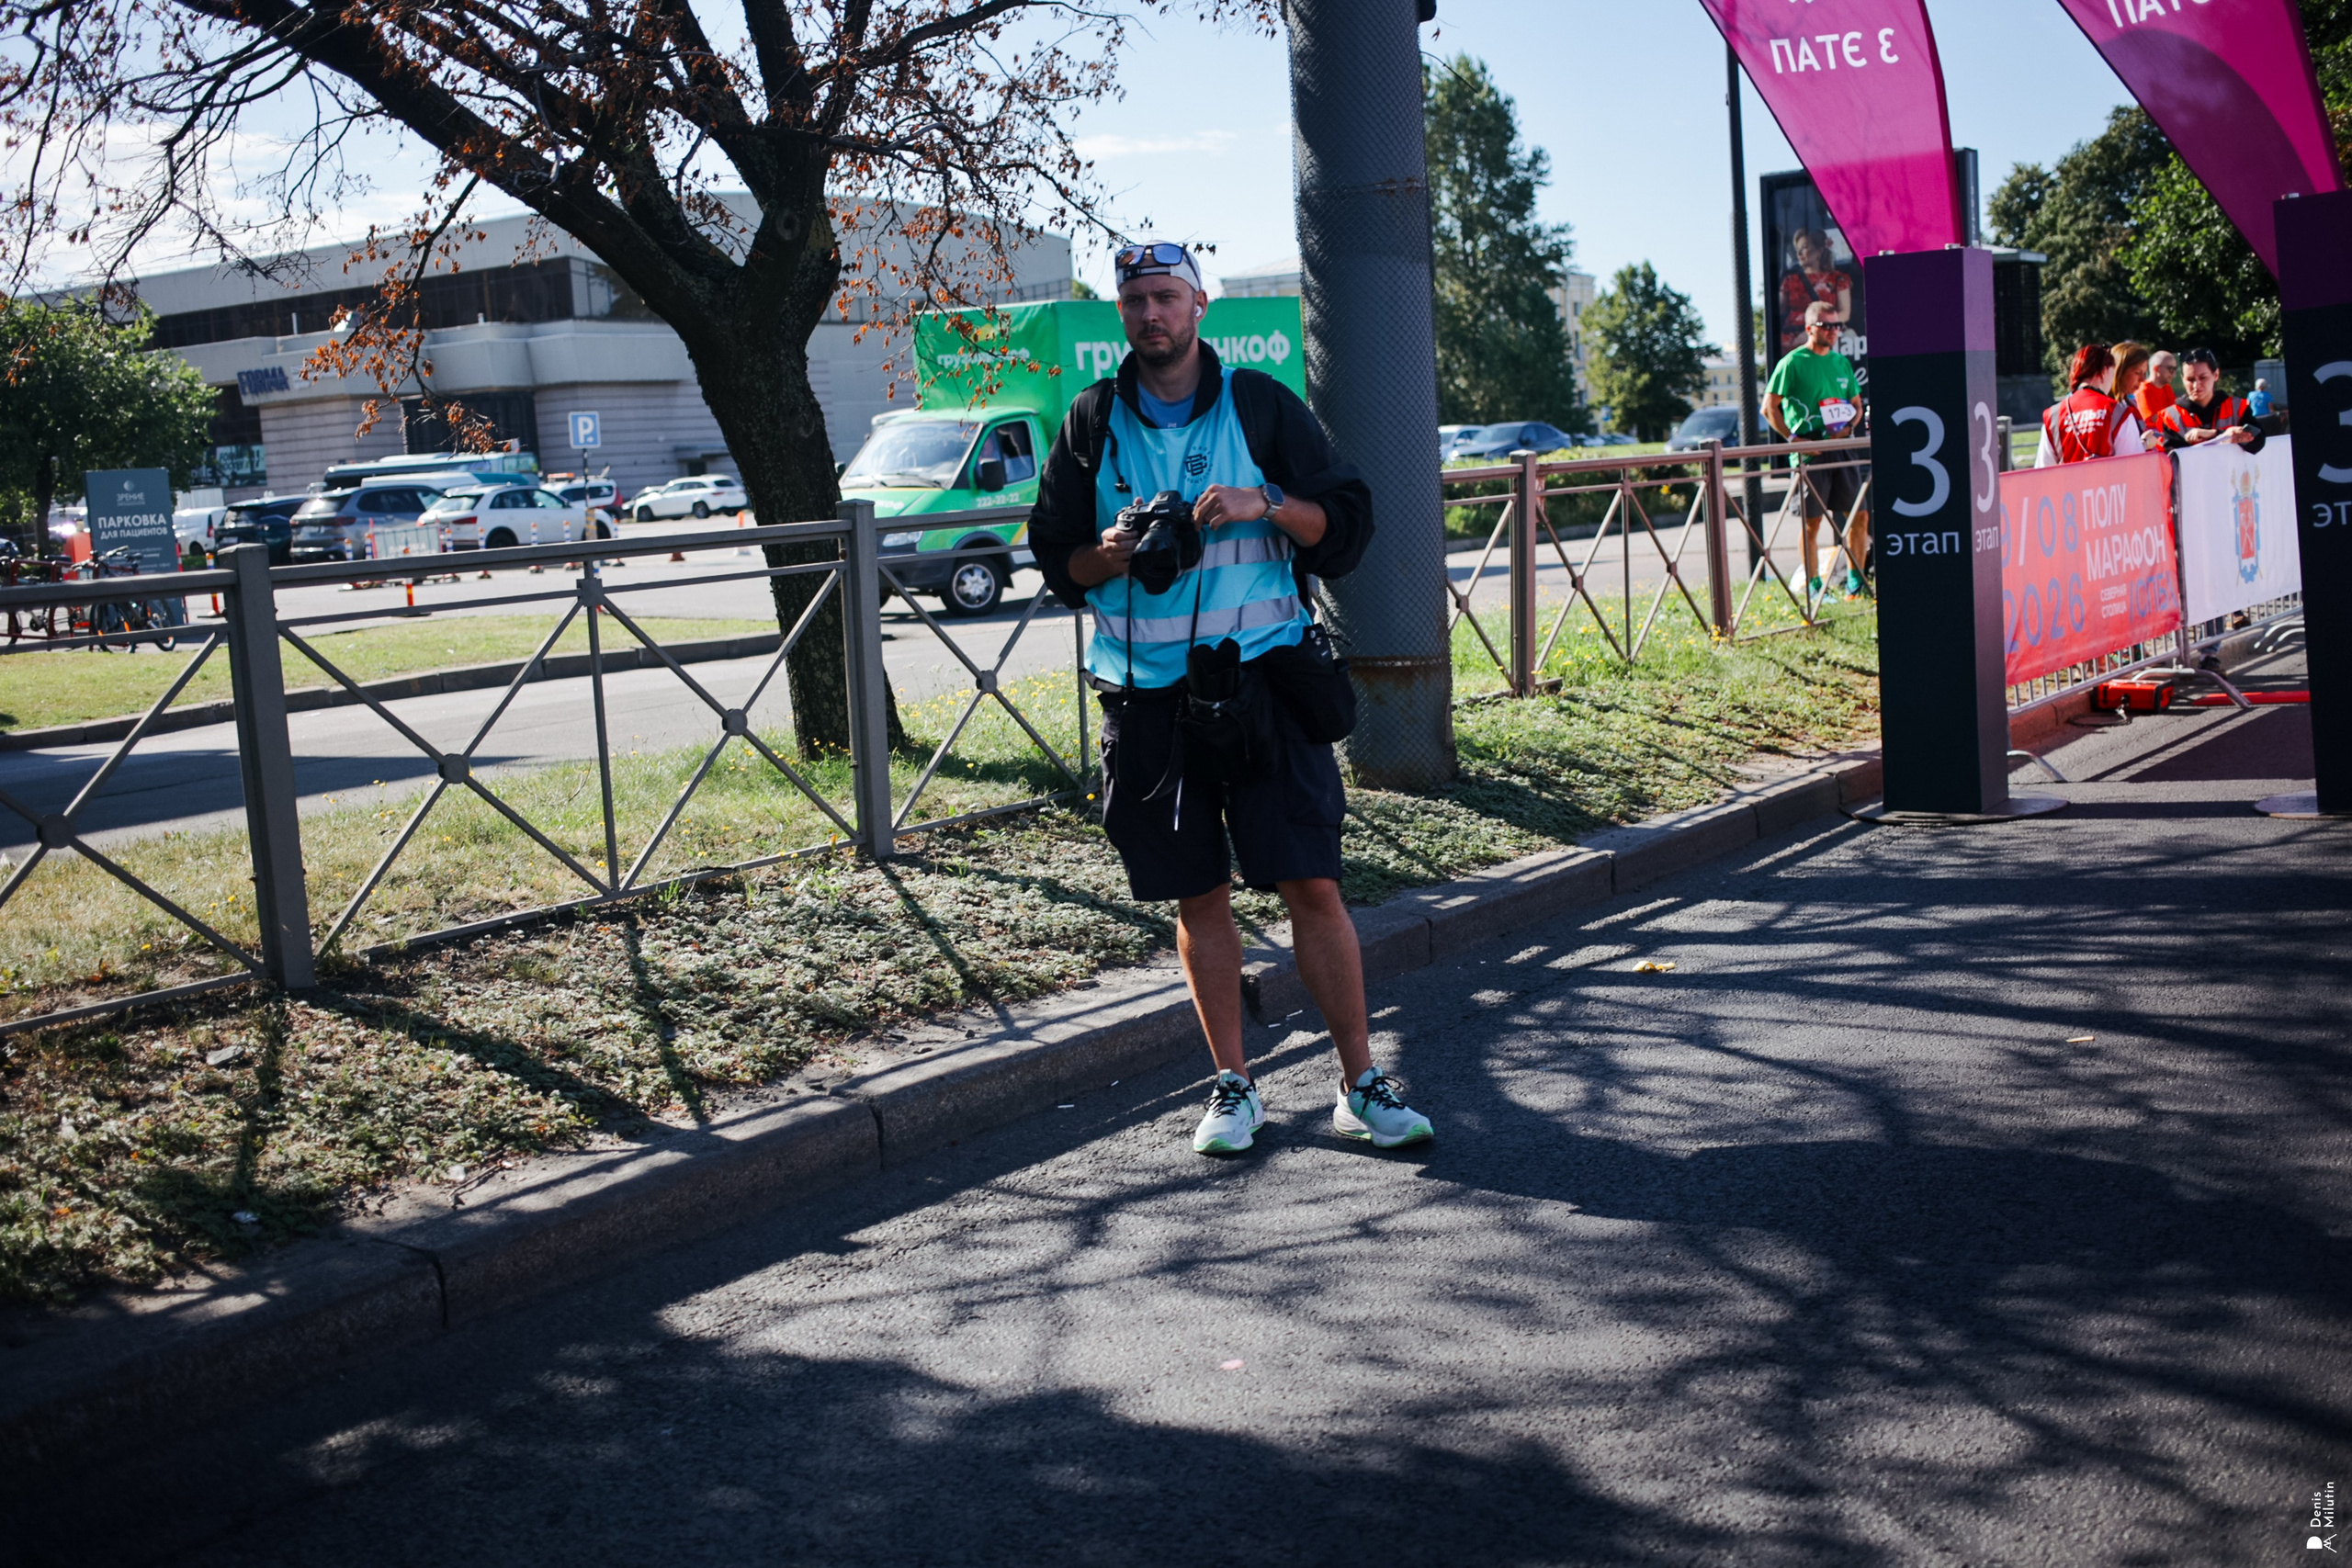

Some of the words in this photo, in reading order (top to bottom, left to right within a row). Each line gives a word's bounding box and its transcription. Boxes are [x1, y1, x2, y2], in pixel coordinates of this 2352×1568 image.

[578, 416, 594, 444] P
[2312, 360, 2352, 484] 3
[1891, 406, 1951, 517] 3
[1974, 401, 1996, 513] 3
[2082, 482, 2128, 532] ПОЛУ
[2312, 501, 2352, 528] эт
[97, 513, 167, 529] ПАРКОВКА
[100, 529, 119, 540] ДЛЯ
[119, 526, 168, 538] ПАЦИЕНТОВ
[1886, 531, 1961, 556] этап
[1975, 526, 1999, 553] этап
[2085, 523, 2167, 583] МАРАФОН
[2100, 582, 2128, 603] СЕВЕРНАЯ
[2003, 571, 2086, 655] 2026
[2101, 600, 2128, 619] СТОЛИЦА
